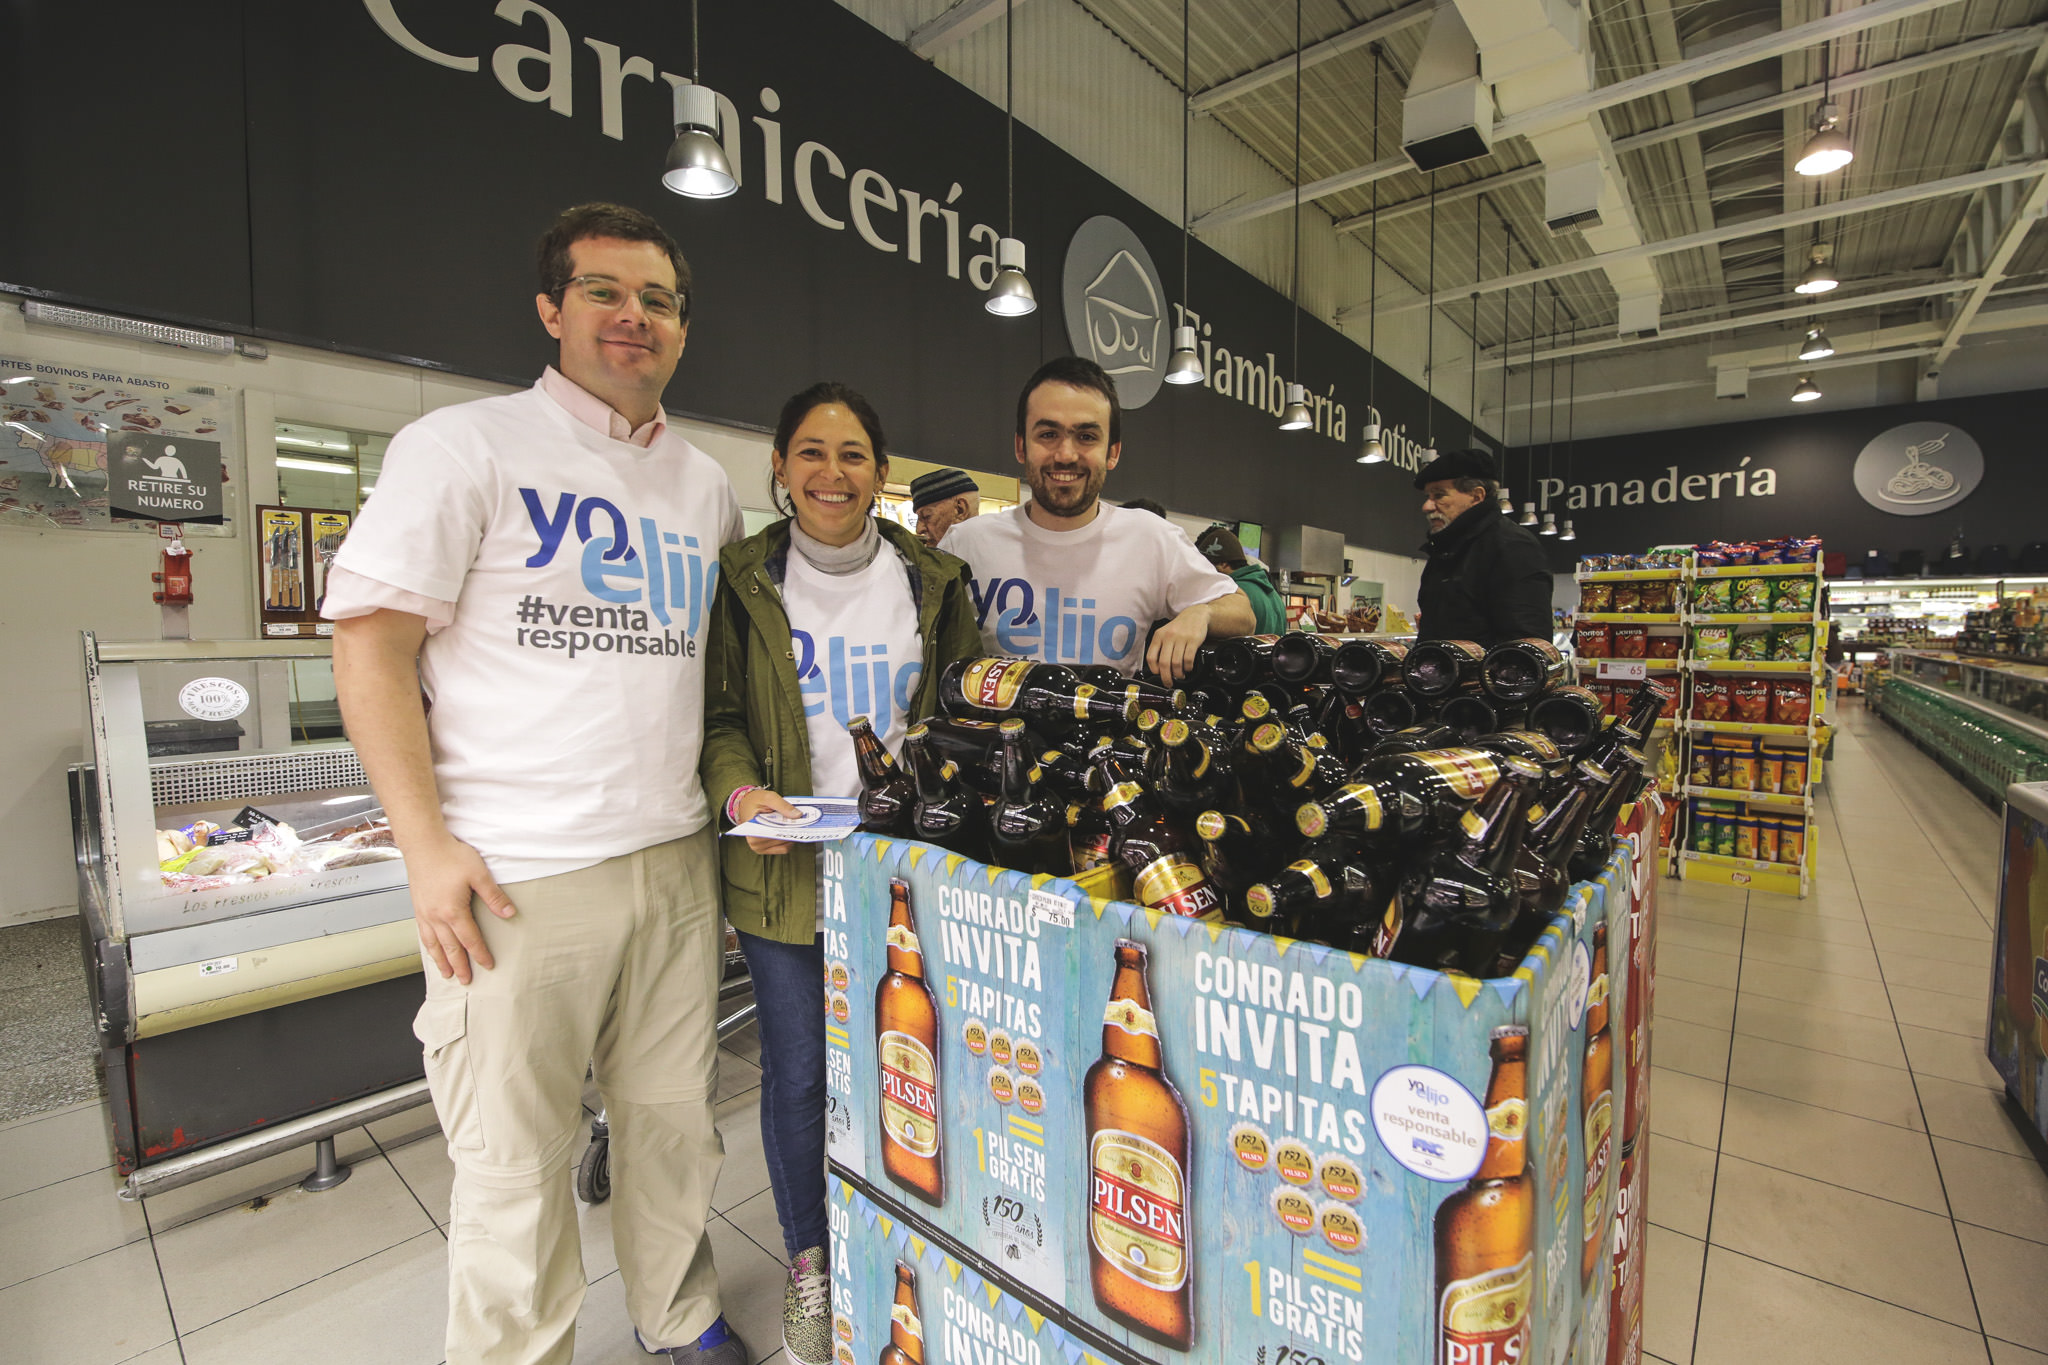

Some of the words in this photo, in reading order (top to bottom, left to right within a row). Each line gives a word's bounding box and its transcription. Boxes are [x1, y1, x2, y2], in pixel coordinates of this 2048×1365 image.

[36, 365, 89, 379] BOVINOS
[93, 372, 123, 384] PARA
[127, 378, 170, 390] ABASTO
[128, 480, 183, 495] RETIRE
[188, 485, 207, 497] SU
[138, 496, 204, 511] NUMERO
[1537, 456, 1776, 511] Panadería
[518, 487, 629, 568] yo
[516, 595, 649, 632] #venta
[996, 587, 1137, 664] elijo
[516, 627, 696, 659] responsable
[981, 660, 1016, 706] ILSEN
[1630, 665, 1643, 675] 65
[938, 884, 1041, 939] CONRADO
[1049, 911, 1070, 928] 75.00
[1156, 884, 1219, 917] ILSEN
[941, 919, 1042, 992] INVITA
[946, 974, 958, 1008] 5
[959, 978, 1042, 1039] TAPITAS
[1194, 951, 1363, 1028] CONRADO
[1194, 996, 1366, 1097] INVITA
[881, 1068, 936, 1116] PILSEN
[1200, 1067, 1219, 1108] 5
[1219, 1073, 1366, 1155] TAPITAS
[1408, 1104, 1449, 1126] venta
[972, 1127, 986, 1172] 1
[988, 1131, 1046, 1179] PILSEN
[1383, 1112, 1478, 1148] responsable
[989, 1155, 1046, 1202] GRATIS
[993, 1194, 1024, 1222] 150
[1094, 1176, 1182, 1240] PILSEN
[1243, 1260, 1262, 1317] 1
[1268, 1266, 1363, 1332] PILSEN
[943, 1286, 1041, 1365] CONRADO
[1268, 1297, 1362, 1362] GRATIS
